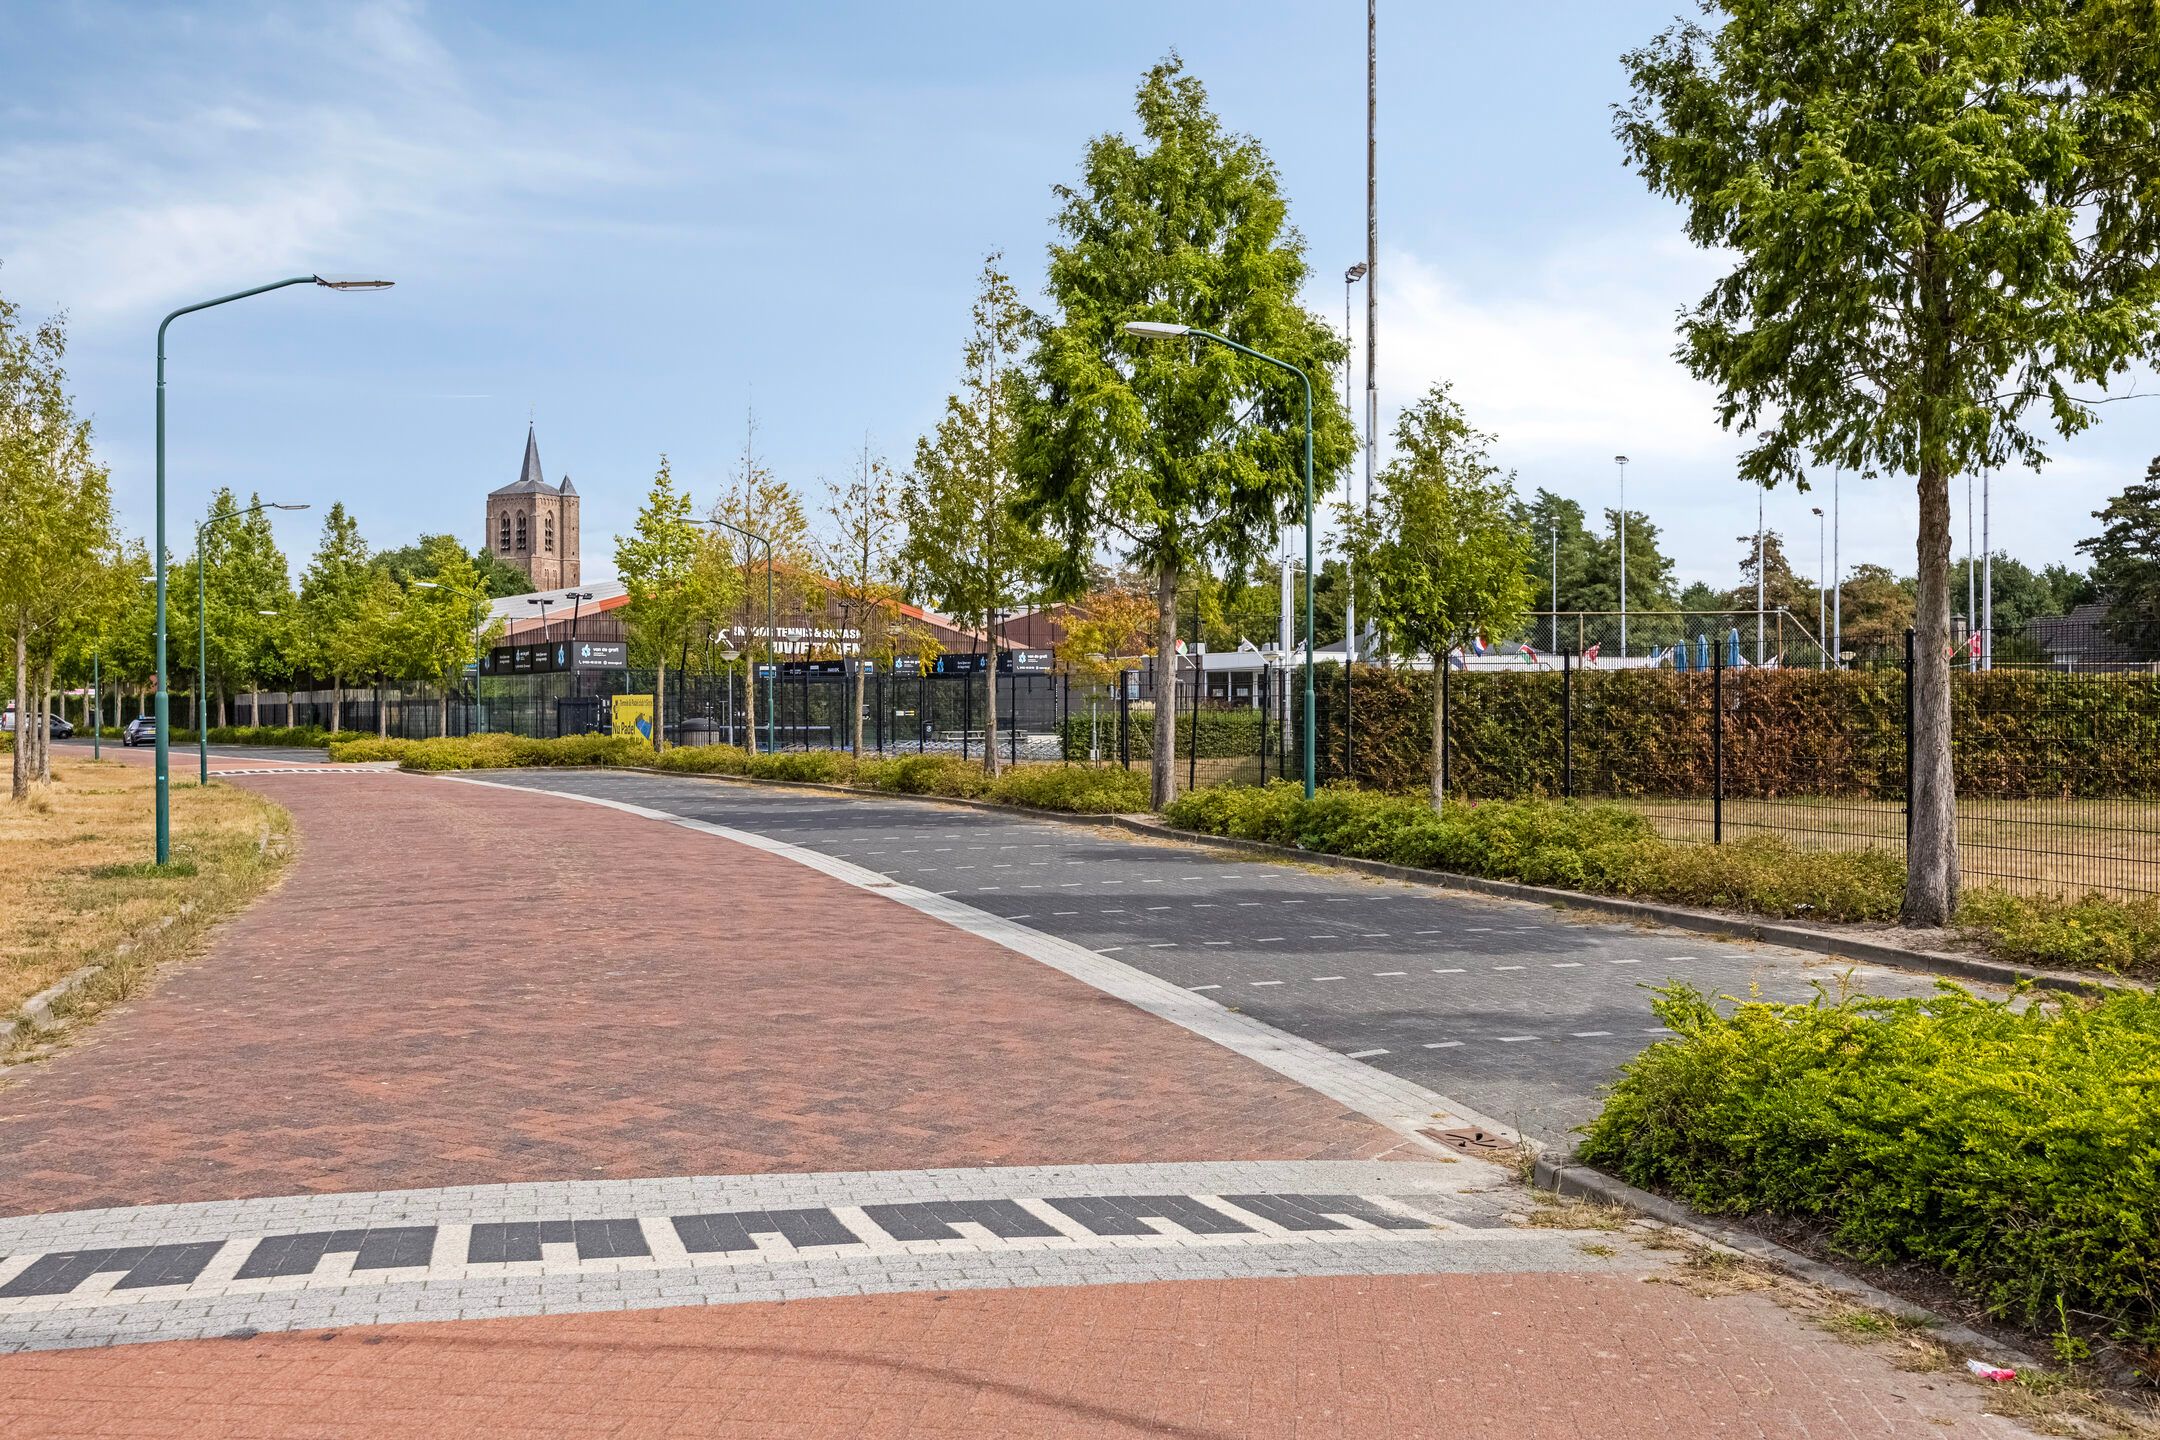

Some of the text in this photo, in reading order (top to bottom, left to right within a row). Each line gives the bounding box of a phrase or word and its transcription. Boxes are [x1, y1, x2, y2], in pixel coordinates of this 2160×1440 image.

[733, 626, 774, 637] INOOR
[776, 627, 813, 638] TENNIS
[814, 628, 822, 638] &
[621, 720, 636, 734] Padel
